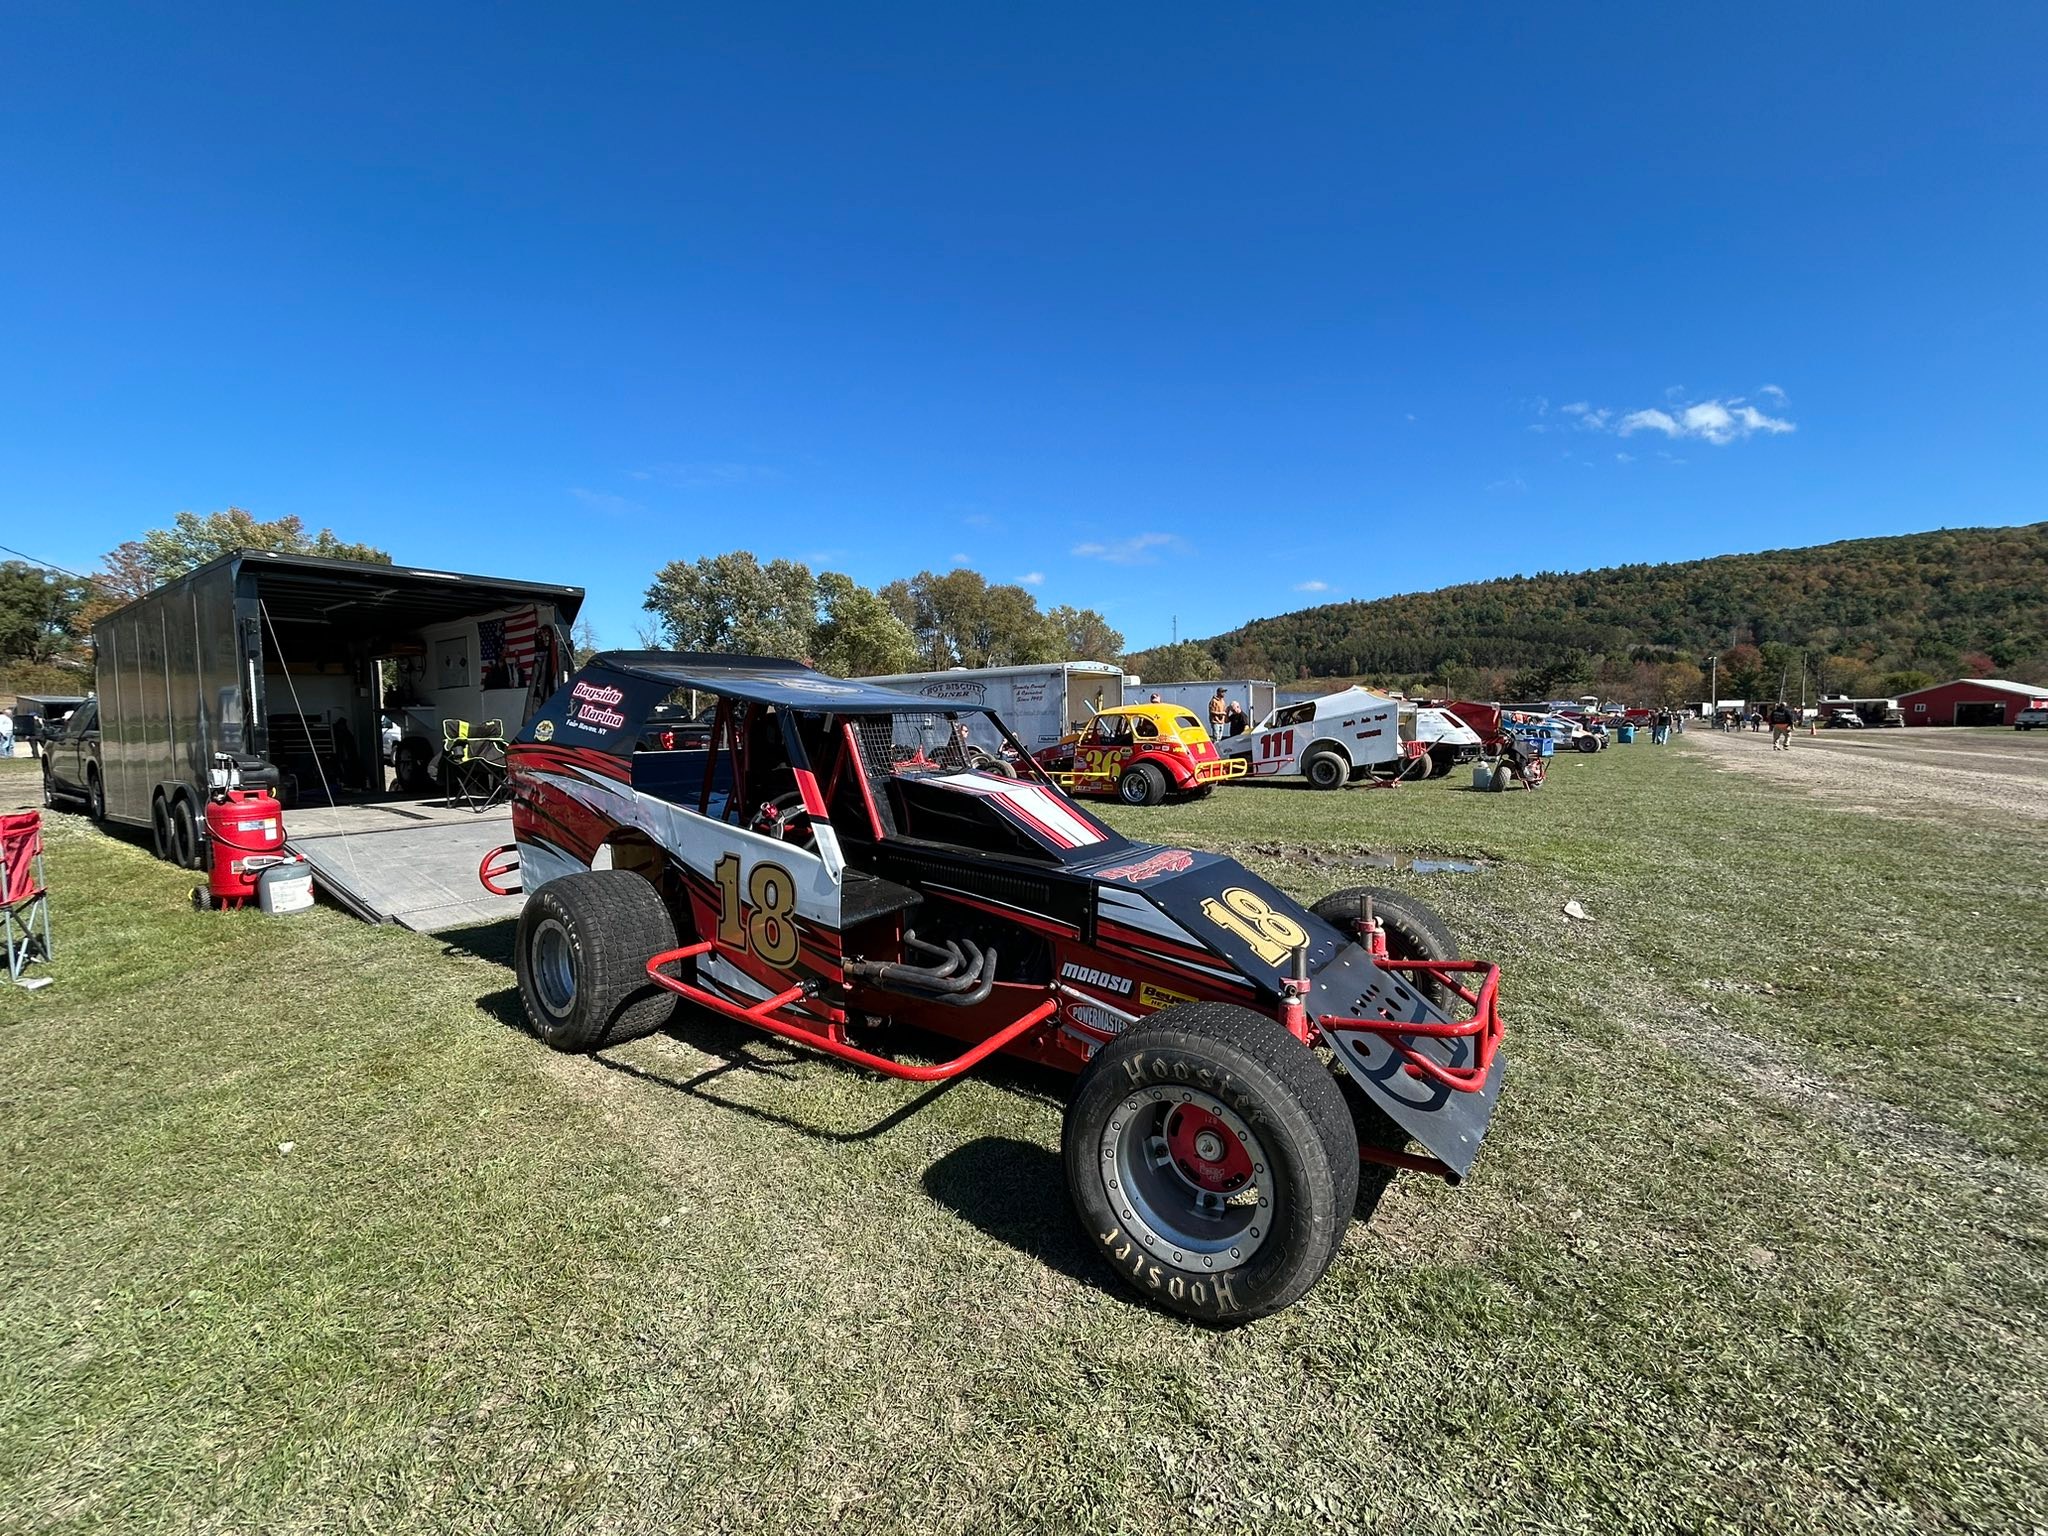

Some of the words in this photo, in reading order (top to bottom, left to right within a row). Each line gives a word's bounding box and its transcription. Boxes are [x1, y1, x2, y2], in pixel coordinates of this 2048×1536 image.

[572, 682, 623, 704] Bayside
[945, 683, 981, 693] BISCUIT
[577, 704, 624, 727] Marina
[1260, 729, 1295, 760] 111
[1084, 750, 1121, 781] 36
[714, 851, 800, 970] 18
[1200, 886, 1311, 968] 18
[1061, 961, 1133, 994] MOROSO
[1100, 1228, 1243, 1317] Hoosier
